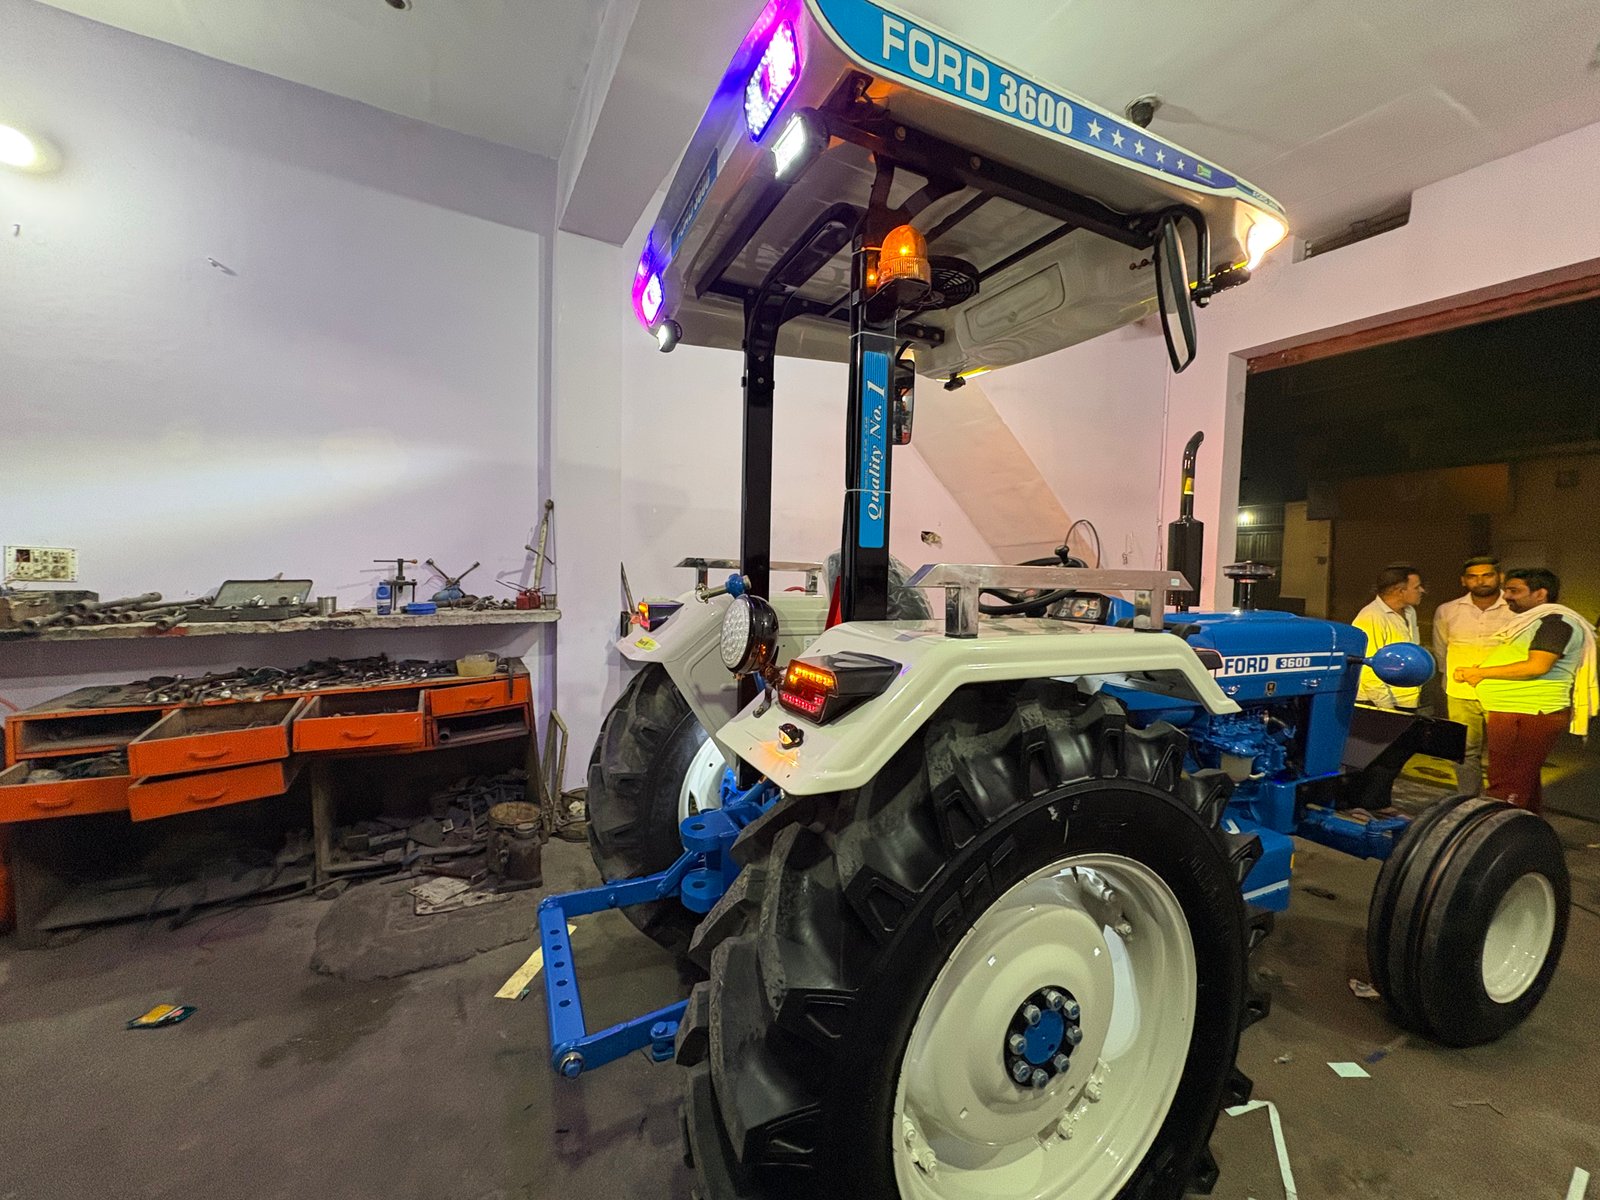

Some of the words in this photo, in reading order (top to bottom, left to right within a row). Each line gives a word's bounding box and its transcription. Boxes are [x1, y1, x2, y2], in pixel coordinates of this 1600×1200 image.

[882, 14, 990, 102] FORD
[1000, 73, 1073, 135] 3600
[867, 379, 885, 399] 1
[869, 405, 882, 439] No.
[867, 445, 885, 521] Quality
[1223, 656, 1269, 675] FORD
[1279, 657, 1311, 669] 3600
